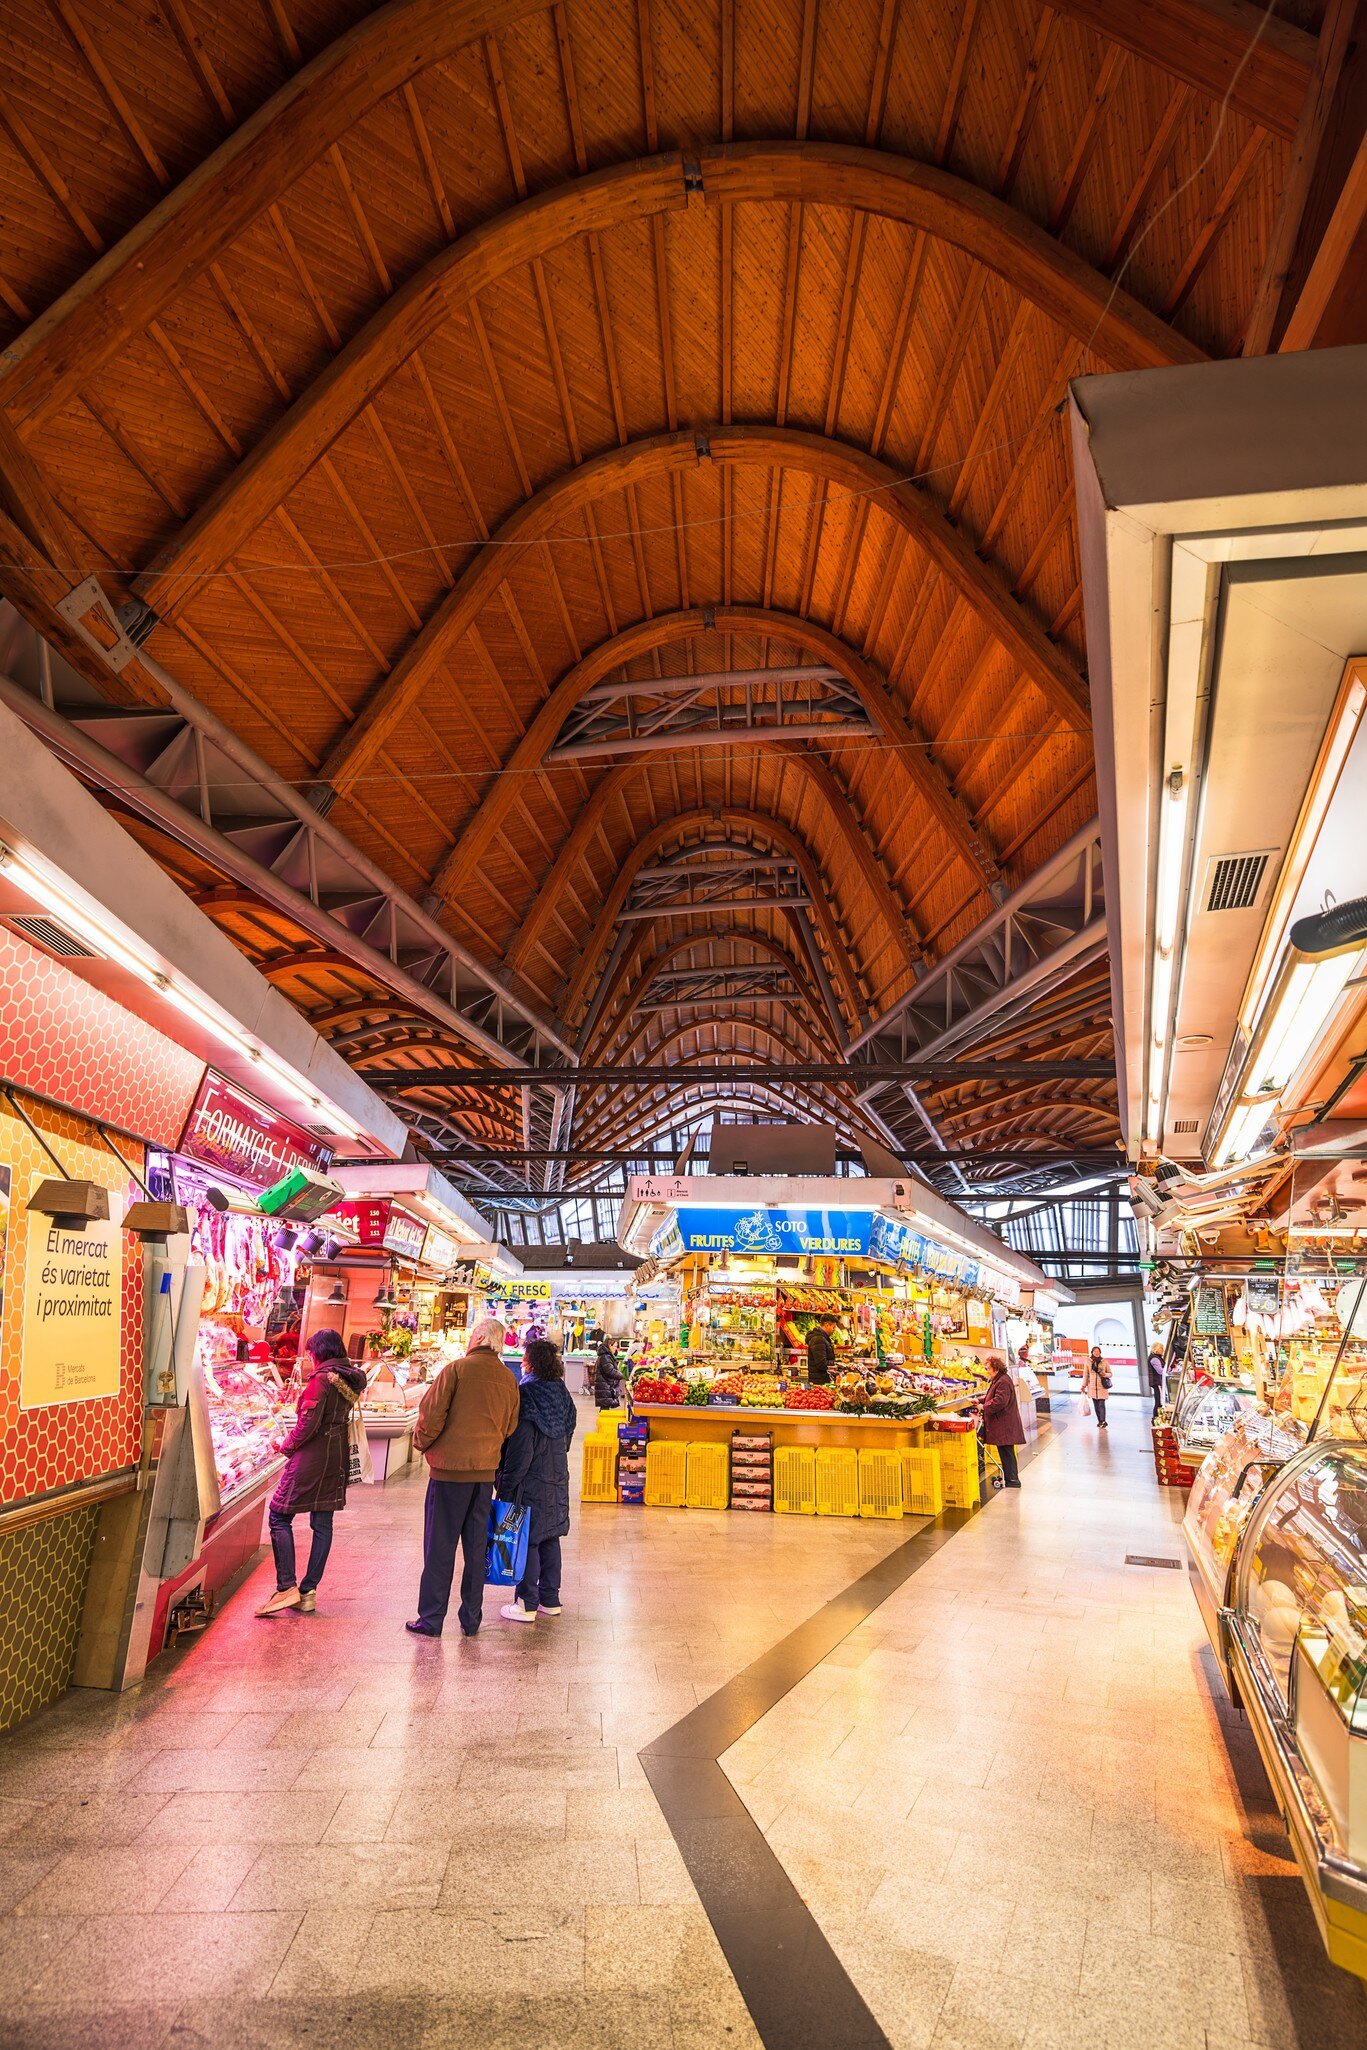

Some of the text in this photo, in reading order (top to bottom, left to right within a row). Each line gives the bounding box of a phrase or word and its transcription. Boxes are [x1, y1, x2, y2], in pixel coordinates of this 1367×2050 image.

[194, 1088, 278, 1174] FORMATGES
[775, 1221, 807, 1233] SOTO
[46, 1230, 108, 1259] El mercat
[690, 1235, 735, 1248] FRUITES
[800, 1238, 861, 1251] VERDURES
[41, 1260, 110, 1287] és varietat
[511, 1285, 547, 1296] FRESC
[36, 1293, 112, 1322] i proximitat
[67, 1364, 86, 1374] Mercats
[67, 1373, 96, 1385] de Barcelona
